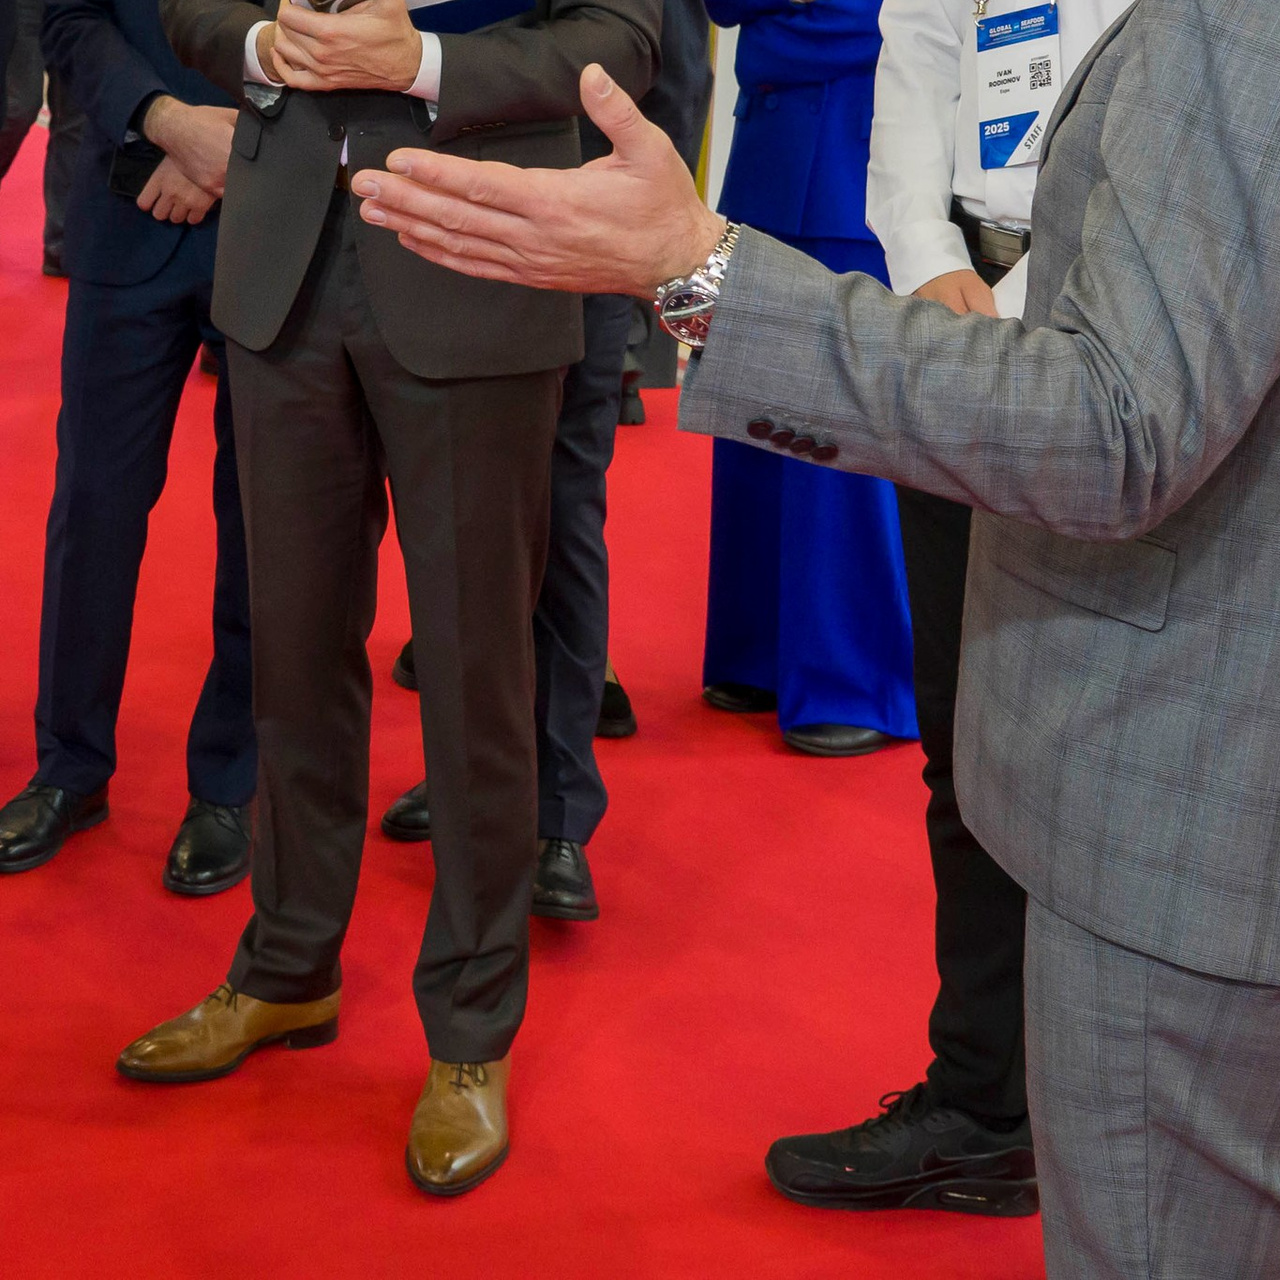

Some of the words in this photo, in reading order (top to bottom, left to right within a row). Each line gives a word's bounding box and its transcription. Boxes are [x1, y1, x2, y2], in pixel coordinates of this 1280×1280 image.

[997, 69, 1012, 78] IVAN
[988, 76, 1021, 88] RODIONOV
[984, 121, 1010, 136] 2025
[1024, 124, 1043, 150] STAFF
